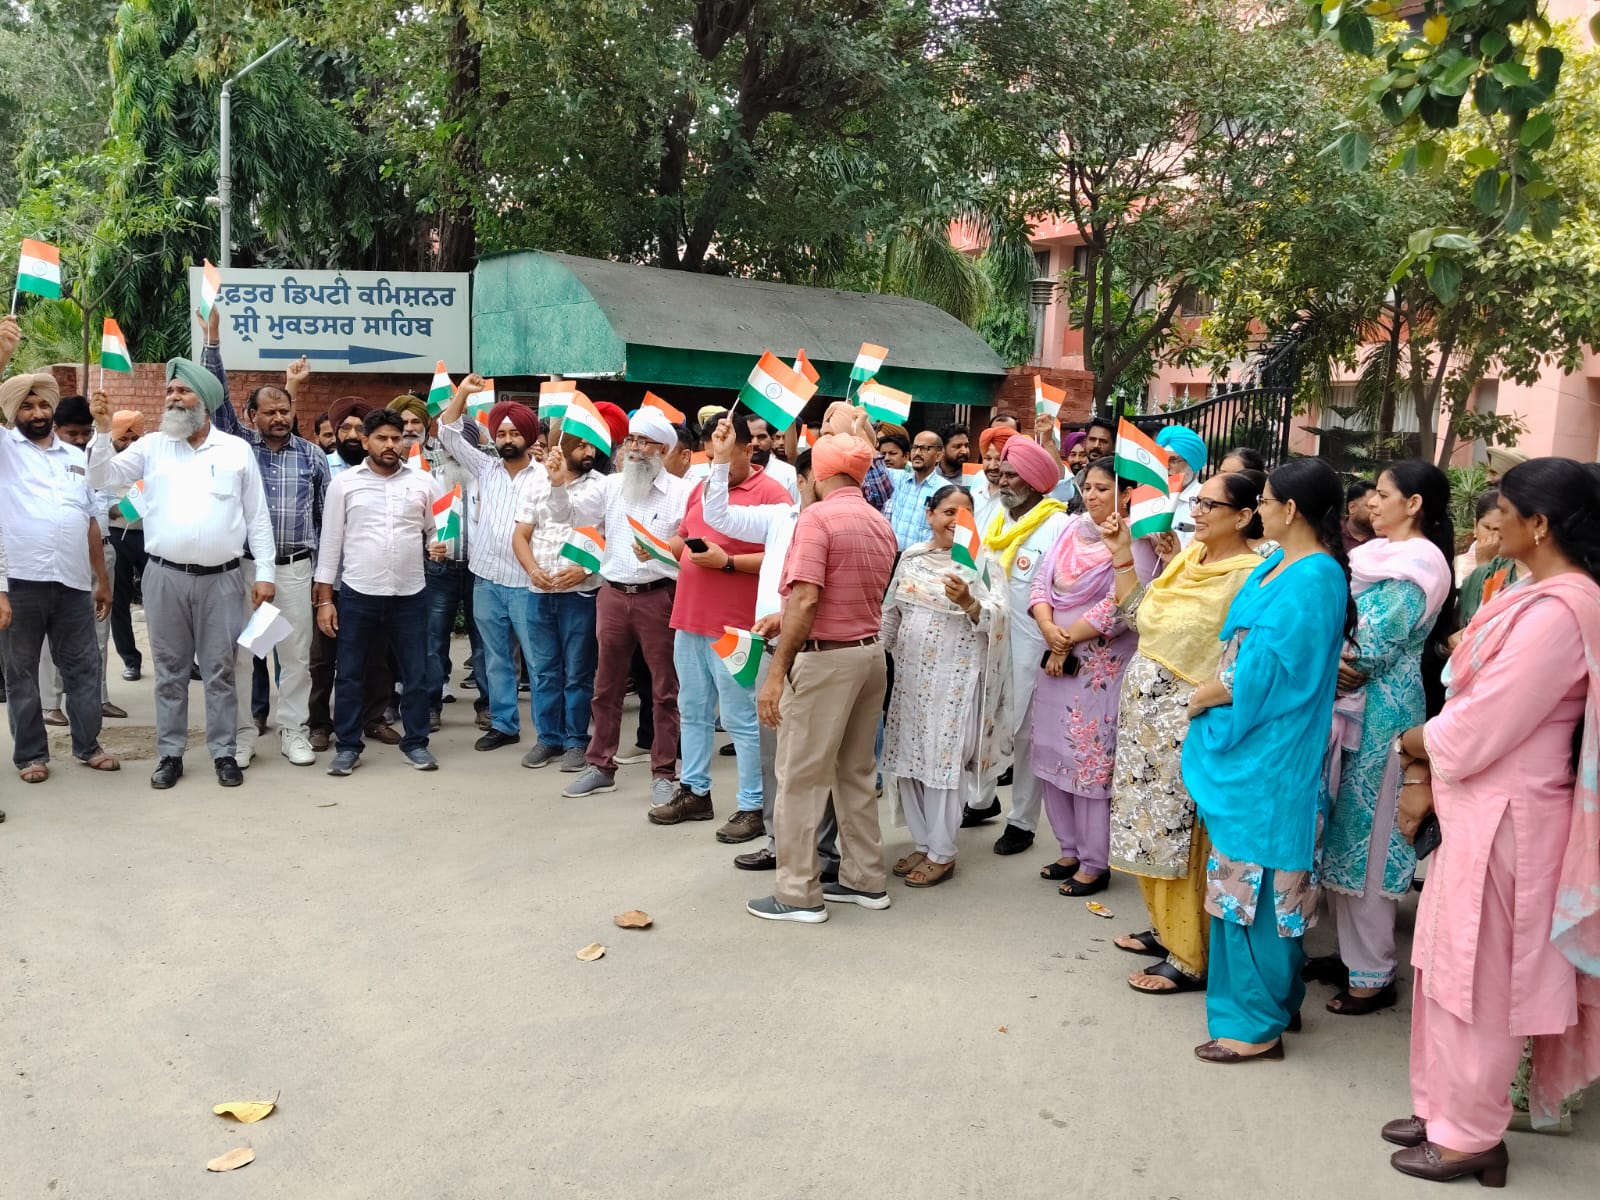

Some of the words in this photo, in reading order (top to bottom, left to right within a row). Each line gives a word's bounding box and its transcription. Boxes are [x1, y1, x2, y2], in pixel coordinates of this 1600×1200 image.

[280, 276, 352, 305] ਡਿਪਟੀ
[356, 277, 456, 307] ਕਮਿਸ਼ਨਰ
[265, 314, 357, 340] ਮੁਕਤਸਰ
[361, 308, 434, 337] ਸਾਹਿਬ
